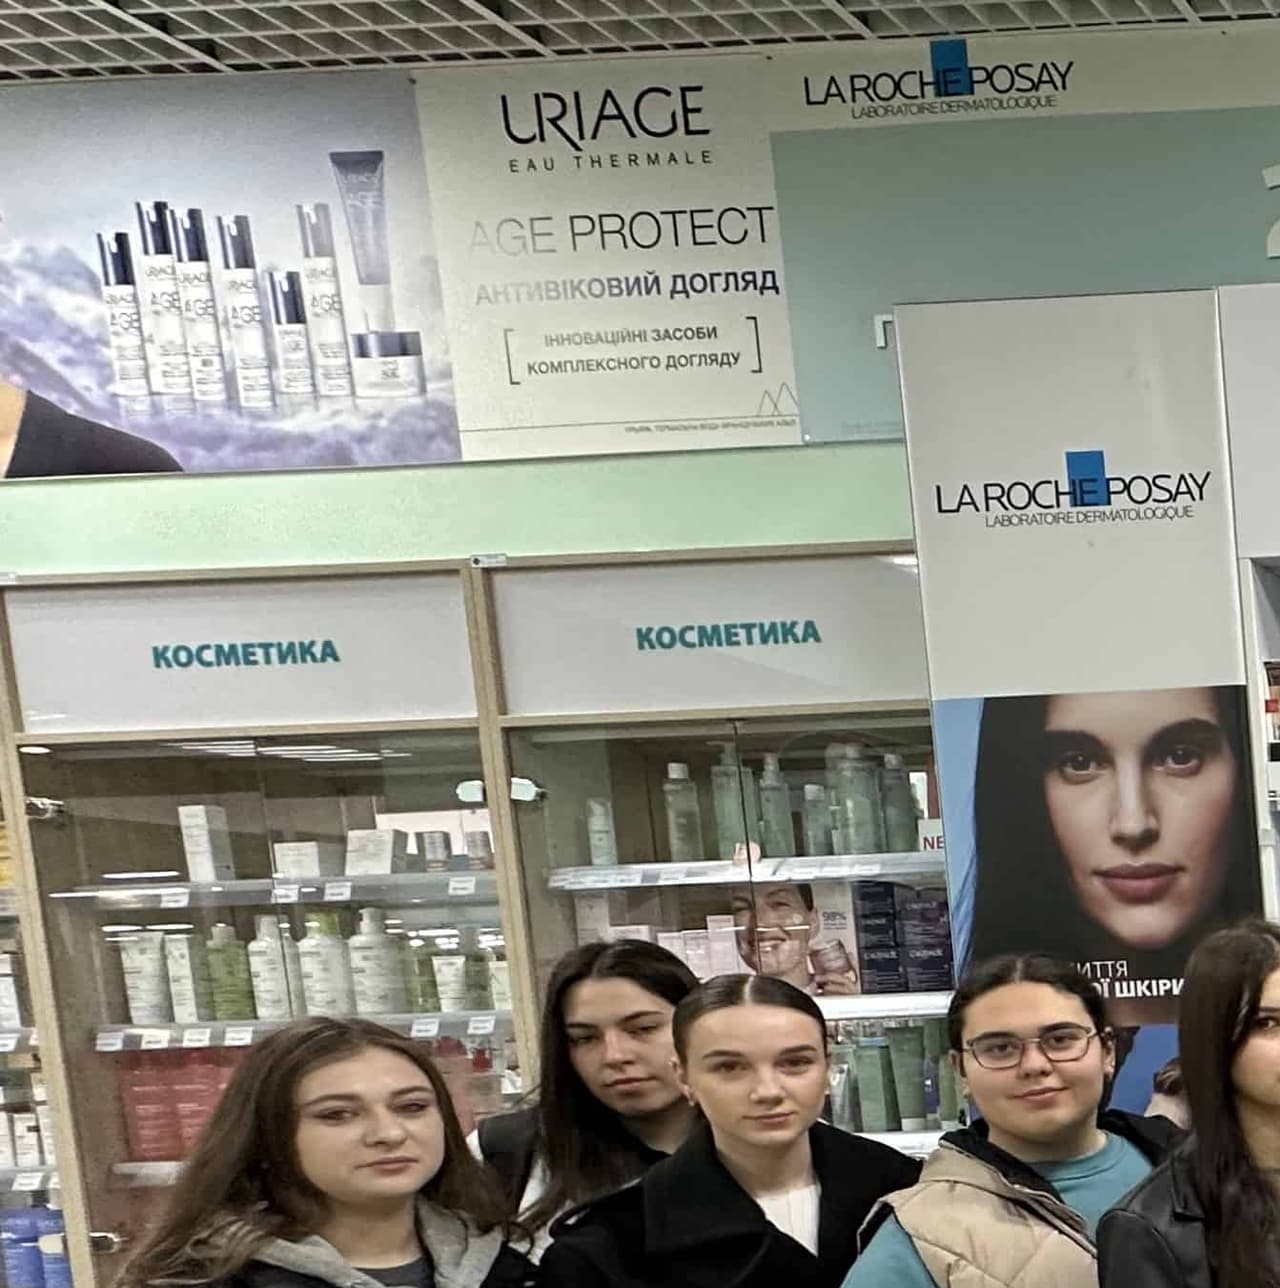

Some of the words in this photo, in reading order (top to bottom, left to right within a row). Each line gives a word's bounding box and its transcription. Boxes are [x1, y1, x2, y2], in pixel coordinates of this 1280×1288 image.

[804, 75, 846, 106] LA
[849, 67, 963, 104] ROCHE
[967, 61, 1075, 96] POSAY
[500, 85, 711, 152] URIAGE
[852, 100, 940, 120] LABORATOIRE
[940, 95, 1057, 115] DERMATOLOGIQUE
[509, 157, 556, 173] EAU
[573, 150, 713, 169] THERMALE
[469, 216, 558, 257] AGE
[568, 205, 775, 252] PROTECT
[474, 270, 662, 306] АНТИВІКОВИЙ
[669, 269, 780, 300] ДОГЛЯД
[544, 326, 648, 348] ІННОВАЦІЙНІ
[651, 325, 718, 343] ЗАСОБИ
[527, 355, 661, 376] КОМПЛЕКСНОГО
[665, 352, 741, 372] ДОГЛЯДУ
[935, 484, 981, 514] LA
[983, 478, 1099, 512] ROCHE
[1105, 471, 1212, 507] POSAY
[985, 512, 1075, 529] LABORATOIRE
[1076, 505, 1195, 526] DERMATOLOGIQUE
[635, 619, 824, 651] КОСМЕТИКА
[151, 639, 341, 670] КОСМЕТИКА
[1076, 959, 1128, 979] ИТТЯ
[1114, 977, 1185, 999] ШКІРИ
